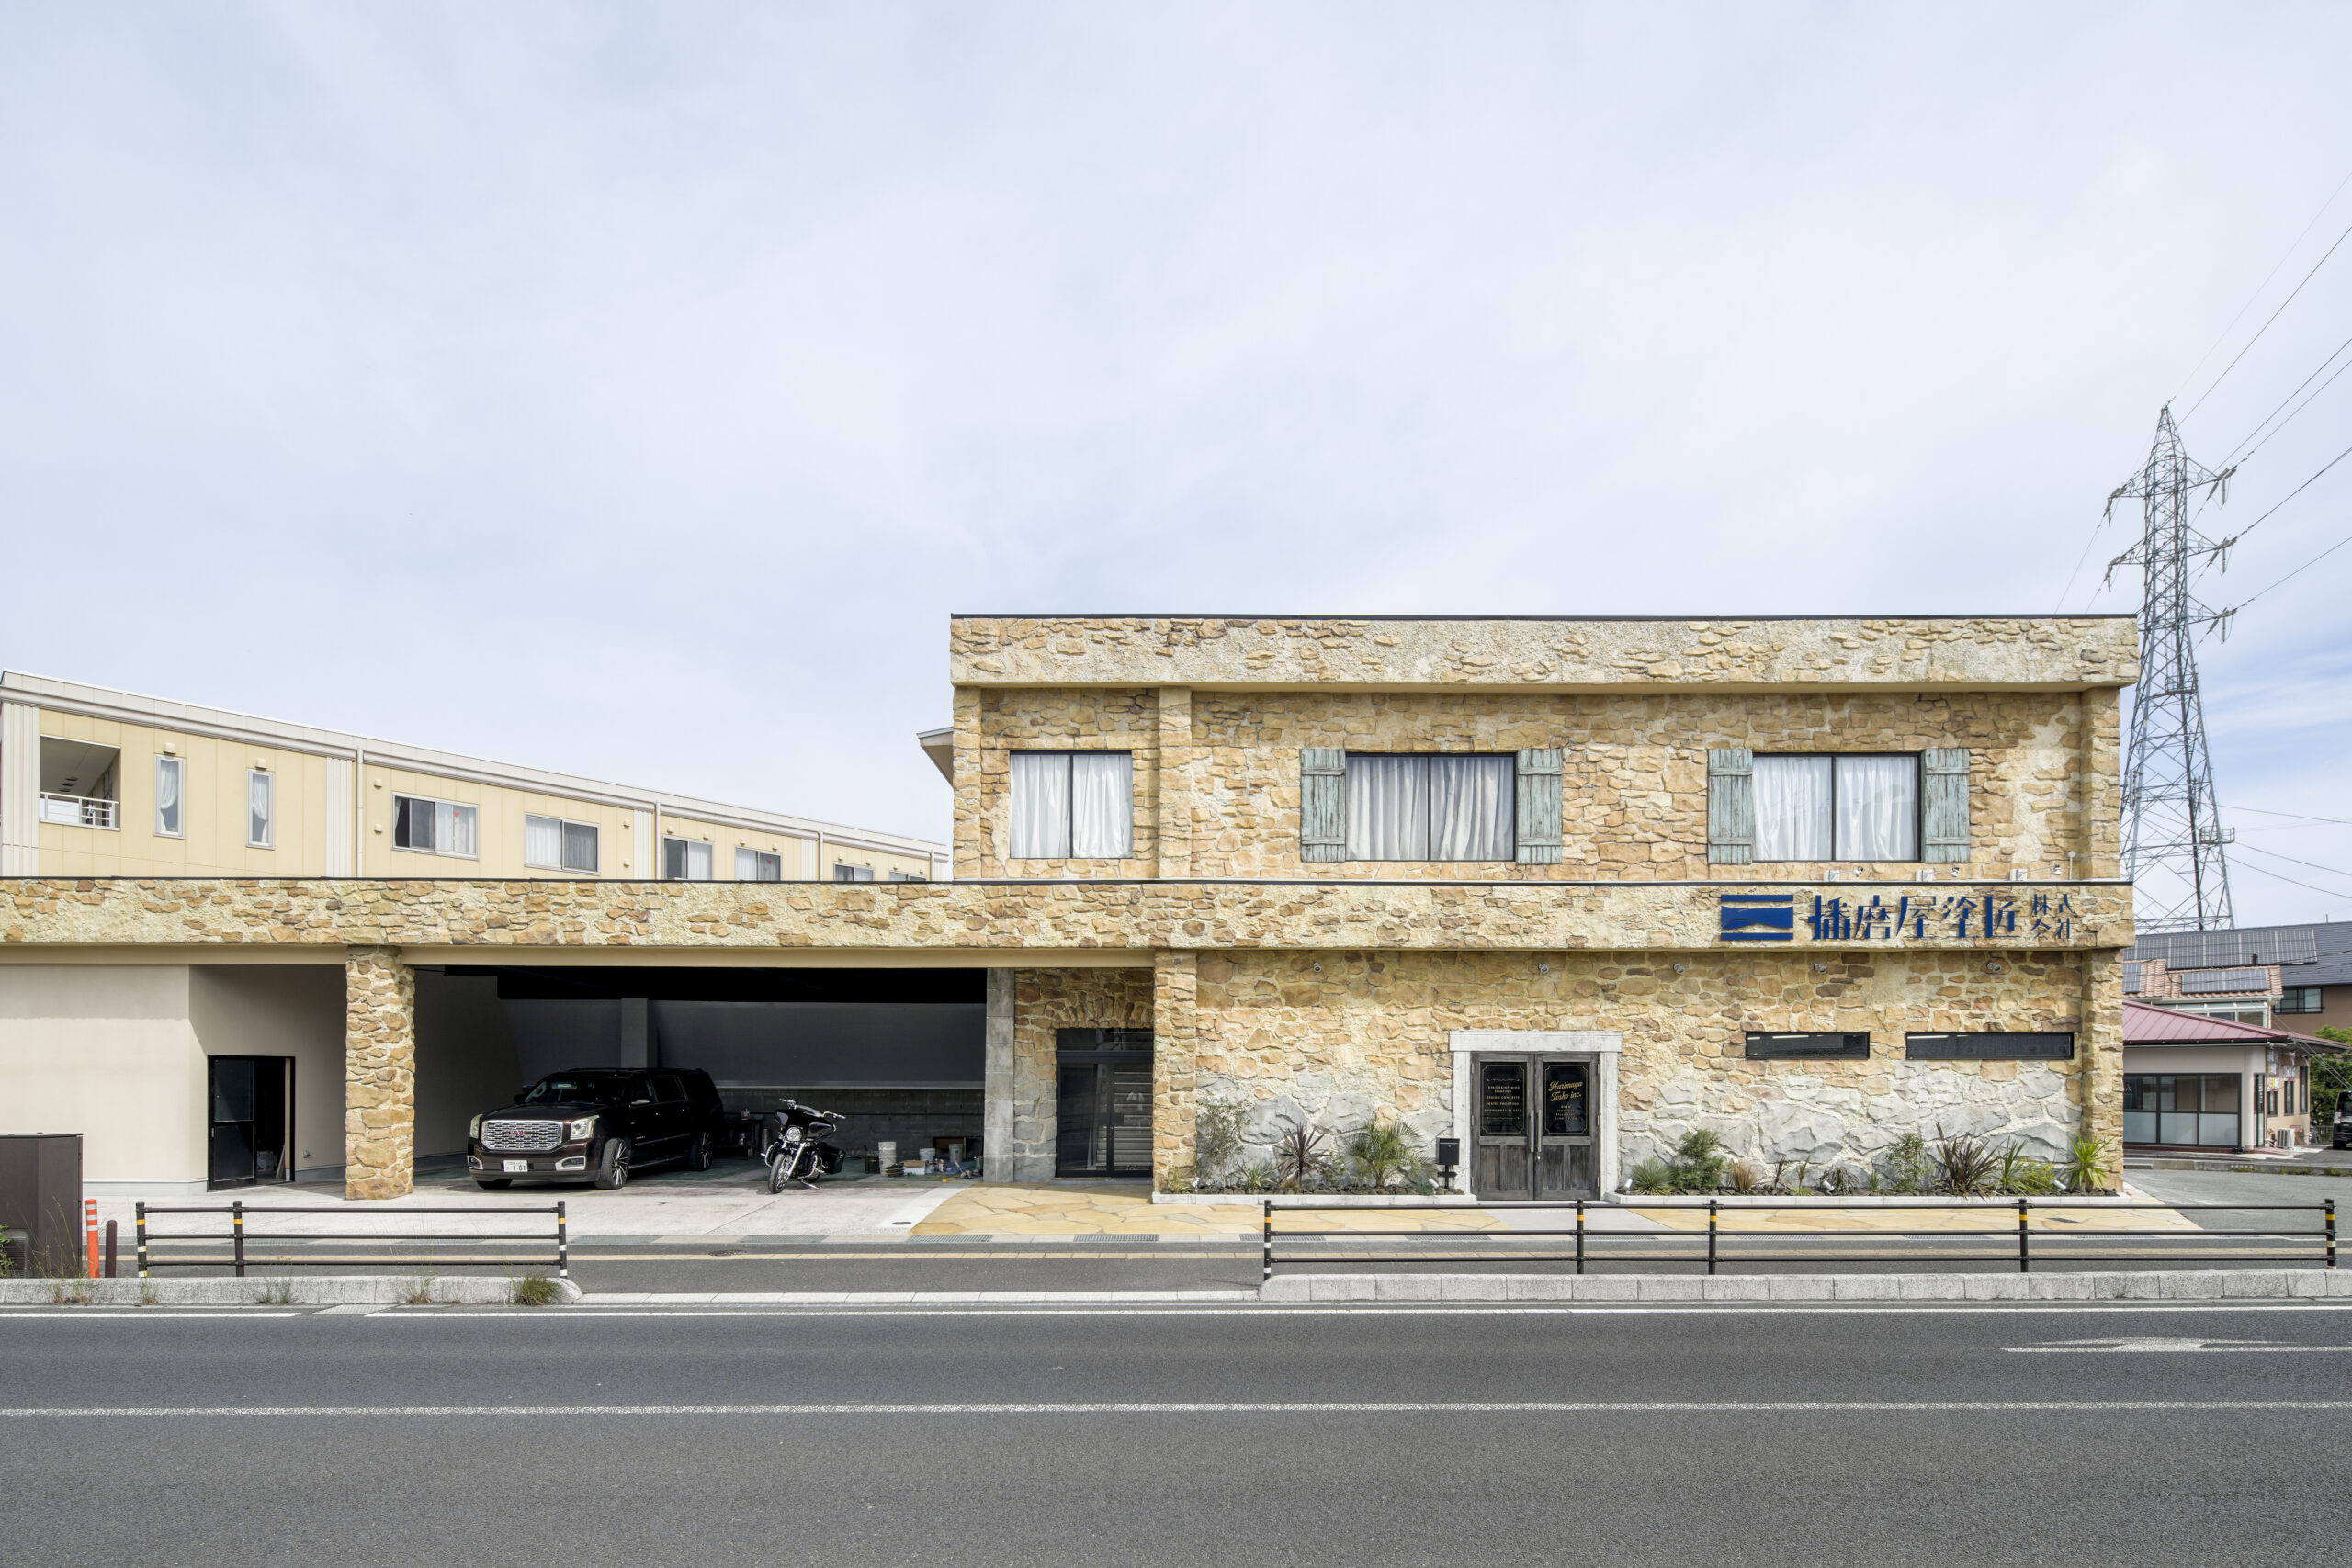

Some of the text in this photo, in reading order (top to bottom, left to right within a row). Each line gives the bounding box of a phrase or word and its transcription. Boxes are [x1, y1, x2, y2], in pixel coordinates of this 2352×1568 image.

[1807, 894, 2021, 940] 播磨屋塗匠
[1548, 1080, 1583, 1091] Harimaya
[1550, 1090, 1569, 1102] Tosho
